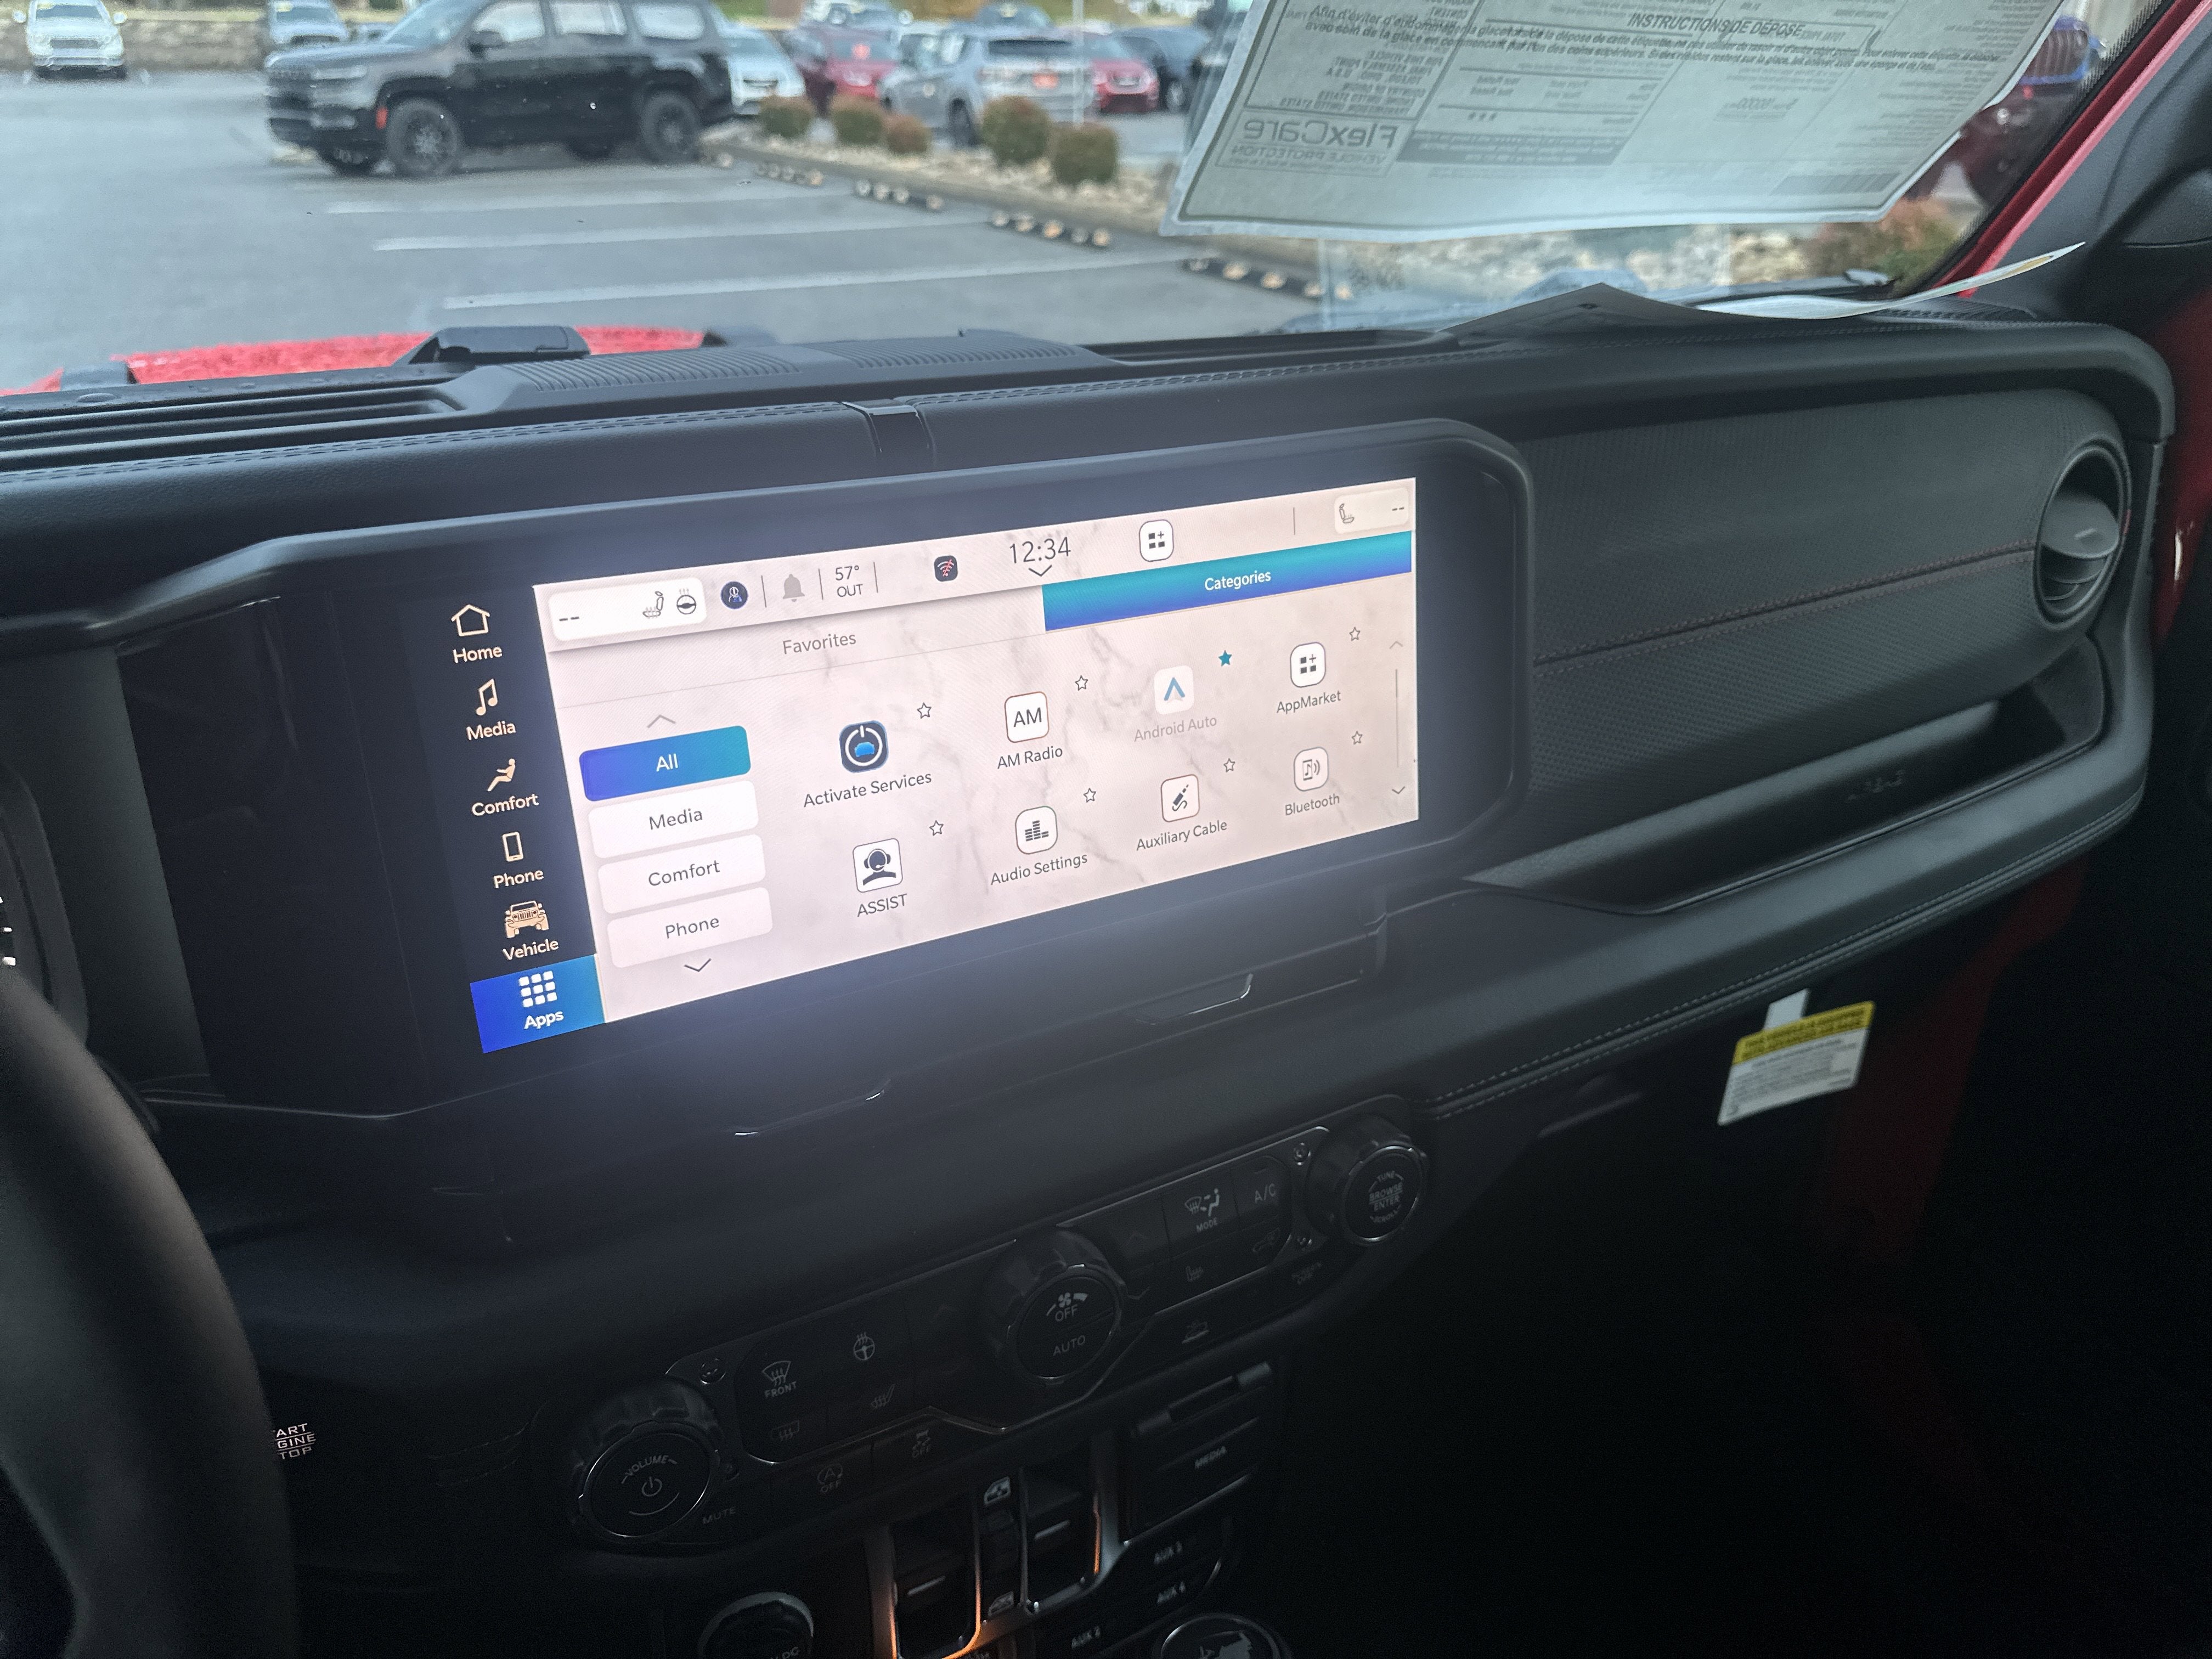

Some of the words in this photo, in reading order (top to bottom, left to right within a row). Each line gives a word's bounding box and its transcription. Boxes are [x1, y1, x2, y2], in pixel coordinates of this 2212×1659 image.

[1308, 5, 1336, 19] Afin
[1555, 31, 1592, 43] dépose
[1593, 33, 1606, 43] de
[1627, 12, 1730, 32] INSTRUCTIONS
[1730, 20, 1751, 33] DE
[1750, 19, 1805, 36] DÉPOSE
[1305, 21, 1334, 32] avec
[1335, 24, 1360, 35] soin
[1362, 27, 1378, 37] de
[1379, 29, 1390, 39] la
[1547, 44, 1566, 54] des
[1009, 536, 1071, 565] 12:34
[834, 565, 860, 581] 57°
[1204, 570, 1272, 591] Categories
[836, 584, 864, 597] OUT
[453, 645, 503, 663] Home
[782, 633, 857, 655] Favorites
[1276, 690, 1342, 715] AppMarket
[1013, 707, 1043, 728] AM
[466, 721, 516, 740] Media
[1133, 719, 1185, 742] Android
[1187, 715, 1218, 732] Auto
[656, 753, 679, 772] All
[997, 753, 1020, 770] AM
[1024, 746, 1064, 767] Radio
[803, 783, 867, 808] Activate
[870, 772, 933, 795] Services
[471, 793, 539, 816] Comfort
[1284, 793, 1341, 816] Bluetooth
[648, 808, 703, 830] Media
[1136, 828, 1190, 851] Auxiliary
[1193, 819, 1228, 838] Cable
[493, 868, 544, 889] Phone
[648, 860, 720, 887] Comfort
[990, 865, 1031, 886] Audio
[1034, 853, 1088, 877] Settings
[856, 894, 908, 918] ASSIST
[665, 916, 720, 939] Phone
[502, 939, 559, 961] Vehicle
[523, 1010, 565, 1030] Apps
[1376, 1170, 1396, 1182] TUNE
[1255, 1183, 1277, 1203] A/C
[1369, 1182, 1403, 1201] BROWSE
[1374, 1194, 1400, 1211] ENTER
[1196, 1218, 1218, 1233] MODE
[1055, 1304, 1078, 1322] OFF
[1053, 1335, 1086, 1356] AUTO
[764, 1381, 797, 1398] FRONT
[276, 1423, 308, 1437] ART
[277, 1433, 317, 1449] GINE
[912, 1443, 932, 1459] OFF
[278, 1446, 312, 1459] TOP
[624, 1454, 669, 1476] VOLUME
[820, 1479, 842, 1493] OFF
[702, 1506, 737, 1525] MUTE
